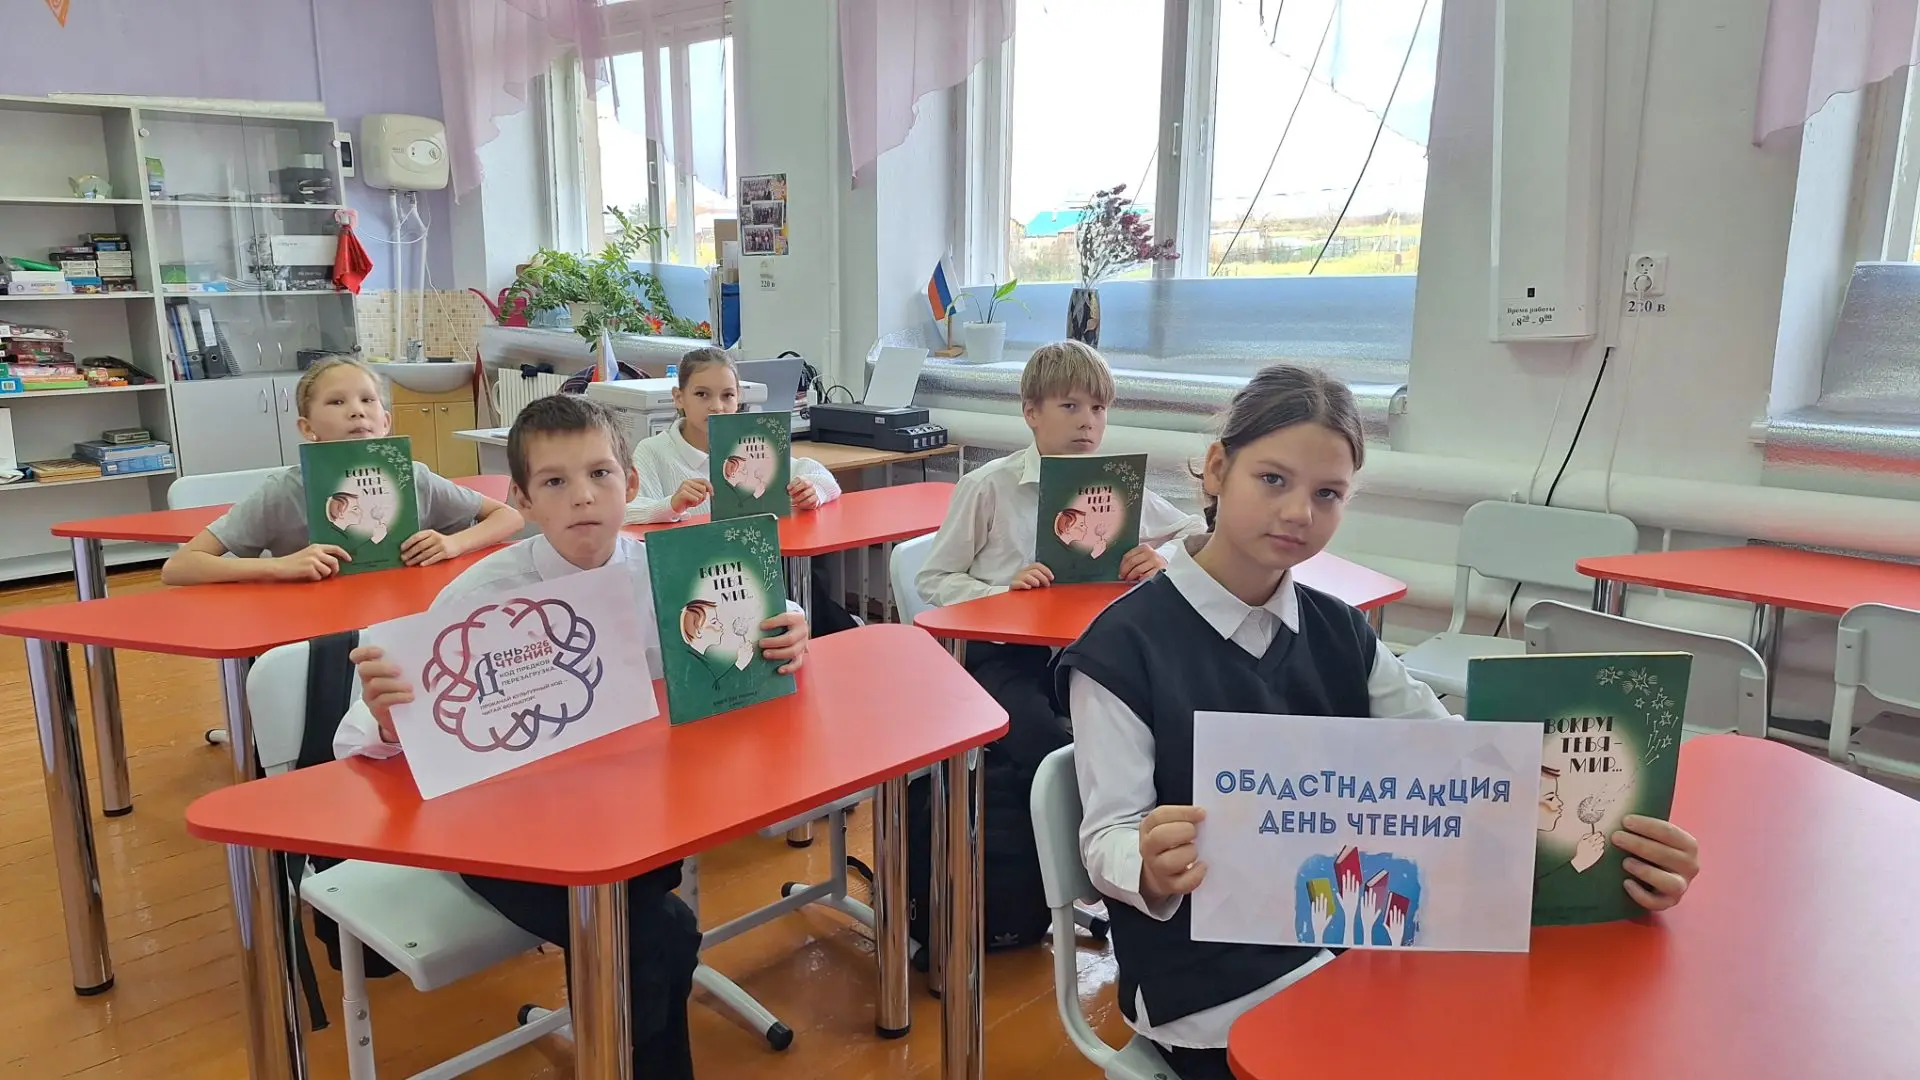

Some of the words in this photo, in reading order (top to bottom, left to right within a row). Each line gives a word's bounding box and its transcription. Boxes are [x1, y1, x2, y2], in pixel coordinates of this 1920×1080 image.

[1529, 306, 1556, 314] работы
[524, 640, 550, 653] 2026
[516, 659, 550, 674] ПРЕДКОВ
[1544, 716, 1615, 734] ВОКРУГ
[1560, 736, 1610, 753] ТЕБЯ
[1215, 769, 1397, 803] ОБЛАСТНАЯ
[1406, 776, 1510, 807] АКЦИЯ
[1259, 810, 1337, 835] ДЕНЬ
[1347, 813, 1462, 838] ЧТЕНИЯ
